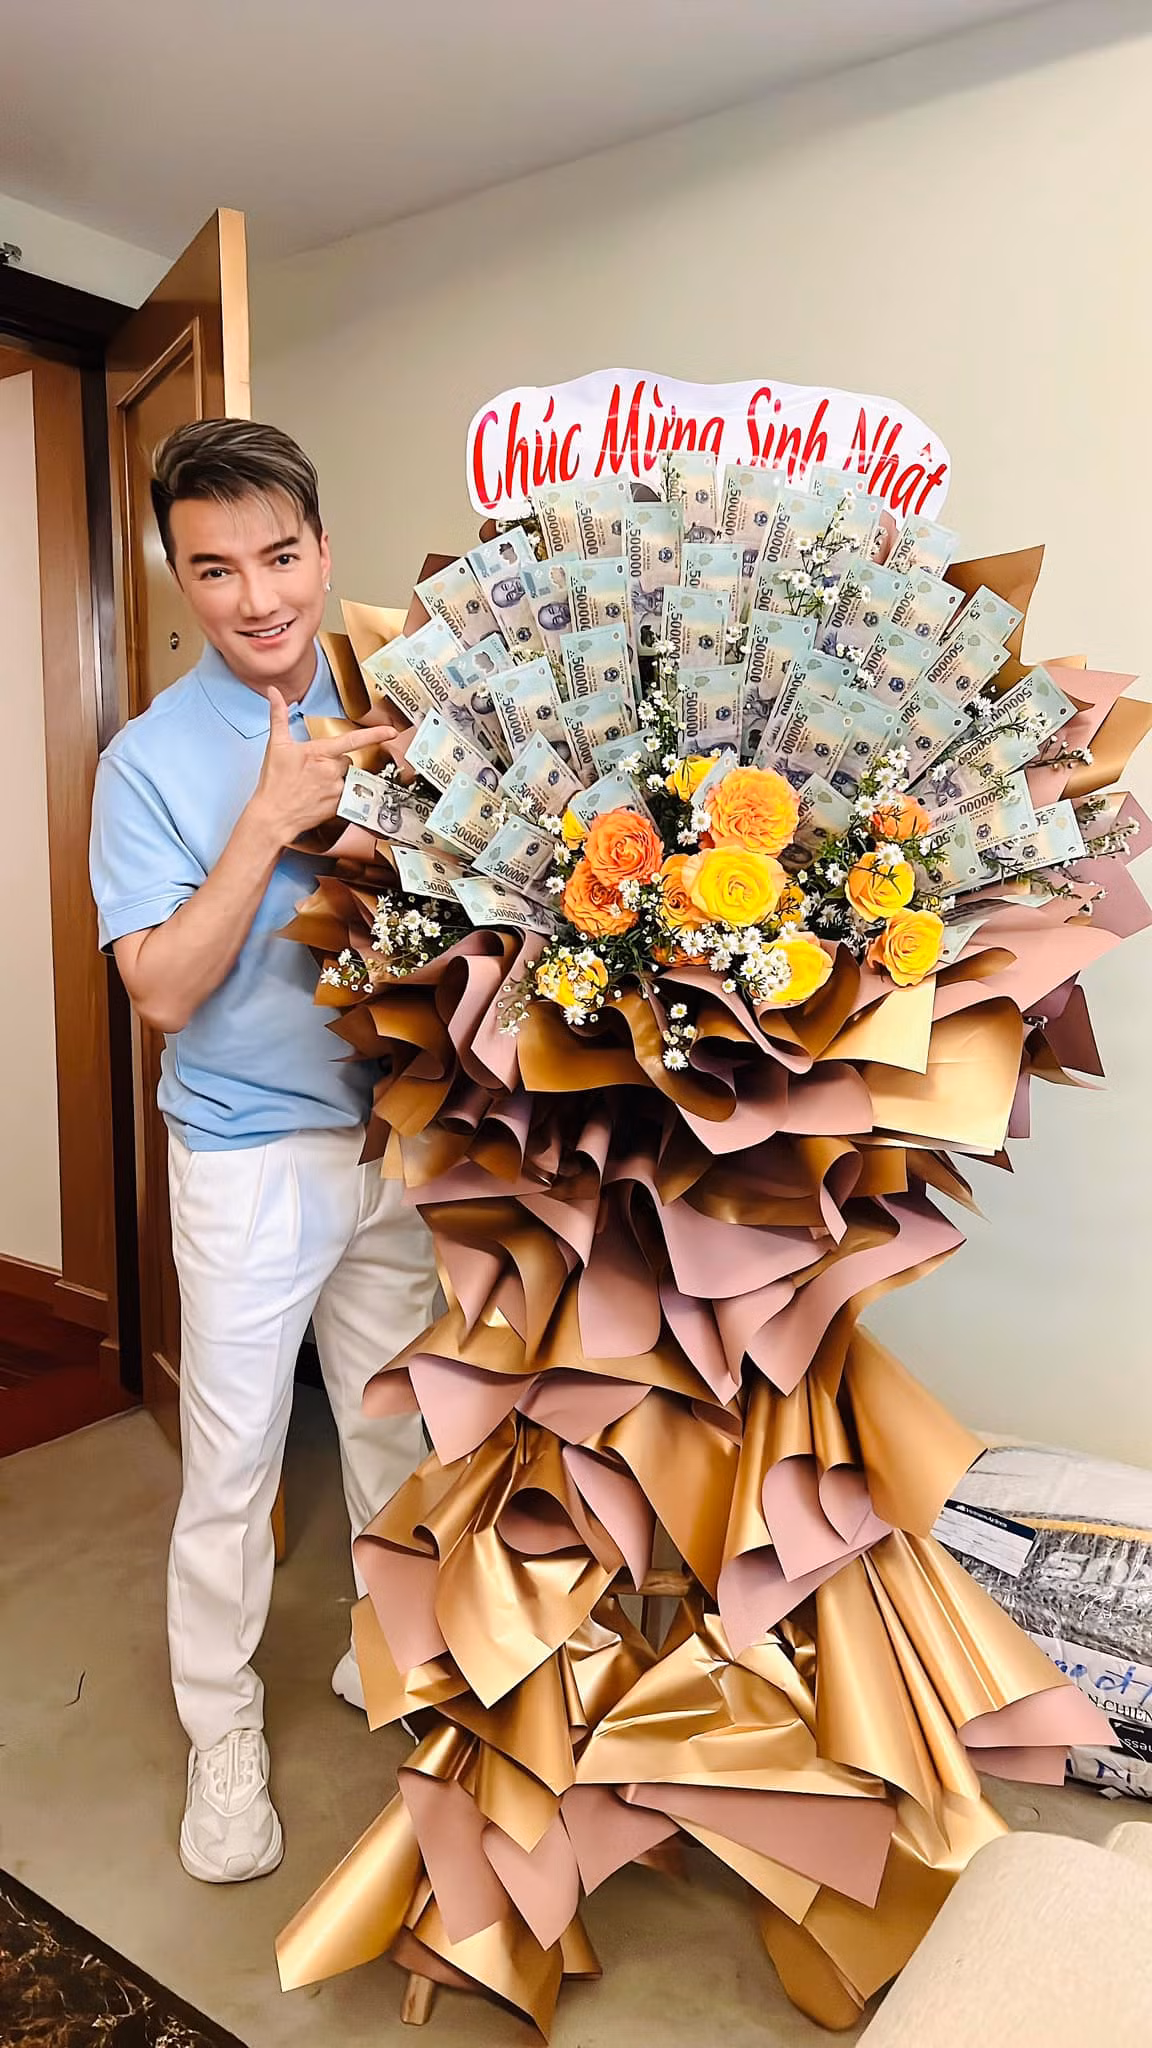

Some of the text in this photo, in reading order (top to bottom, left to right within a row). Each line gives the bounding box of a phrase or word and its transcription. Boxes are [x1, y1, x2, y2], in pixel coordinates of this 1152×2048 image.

[473, 395, 582, 510] Chúc
[736, 387, 829, 484] Sinh
[545, 507, 564, 551] 500000
[580, 507, 599, 555] 500000
[725, 489, 741, 536] 500000
[629, 528, 642, 577] 500000
[767, 513, 790, 562] 500000
[415, 659, 449, 703] 500000
[750, 635, 768, 683] 500000
[927, 643, 965, 683] 500000
[384, 672, 419, 713] 500000
[686, 691, 698, 738] 500000
[502, 697, 527, 743] 500000
[781, 712, 808, 754] 500000
[571, 721, 592, 764] 500000
[958, 732, 999, 766] 500000
[959, 793, 1004, 816] 500000
[451, 823, 488, 851] 500000
[493, 860, 529, 885] 500000
[490, 908, 526, 922] 500000
